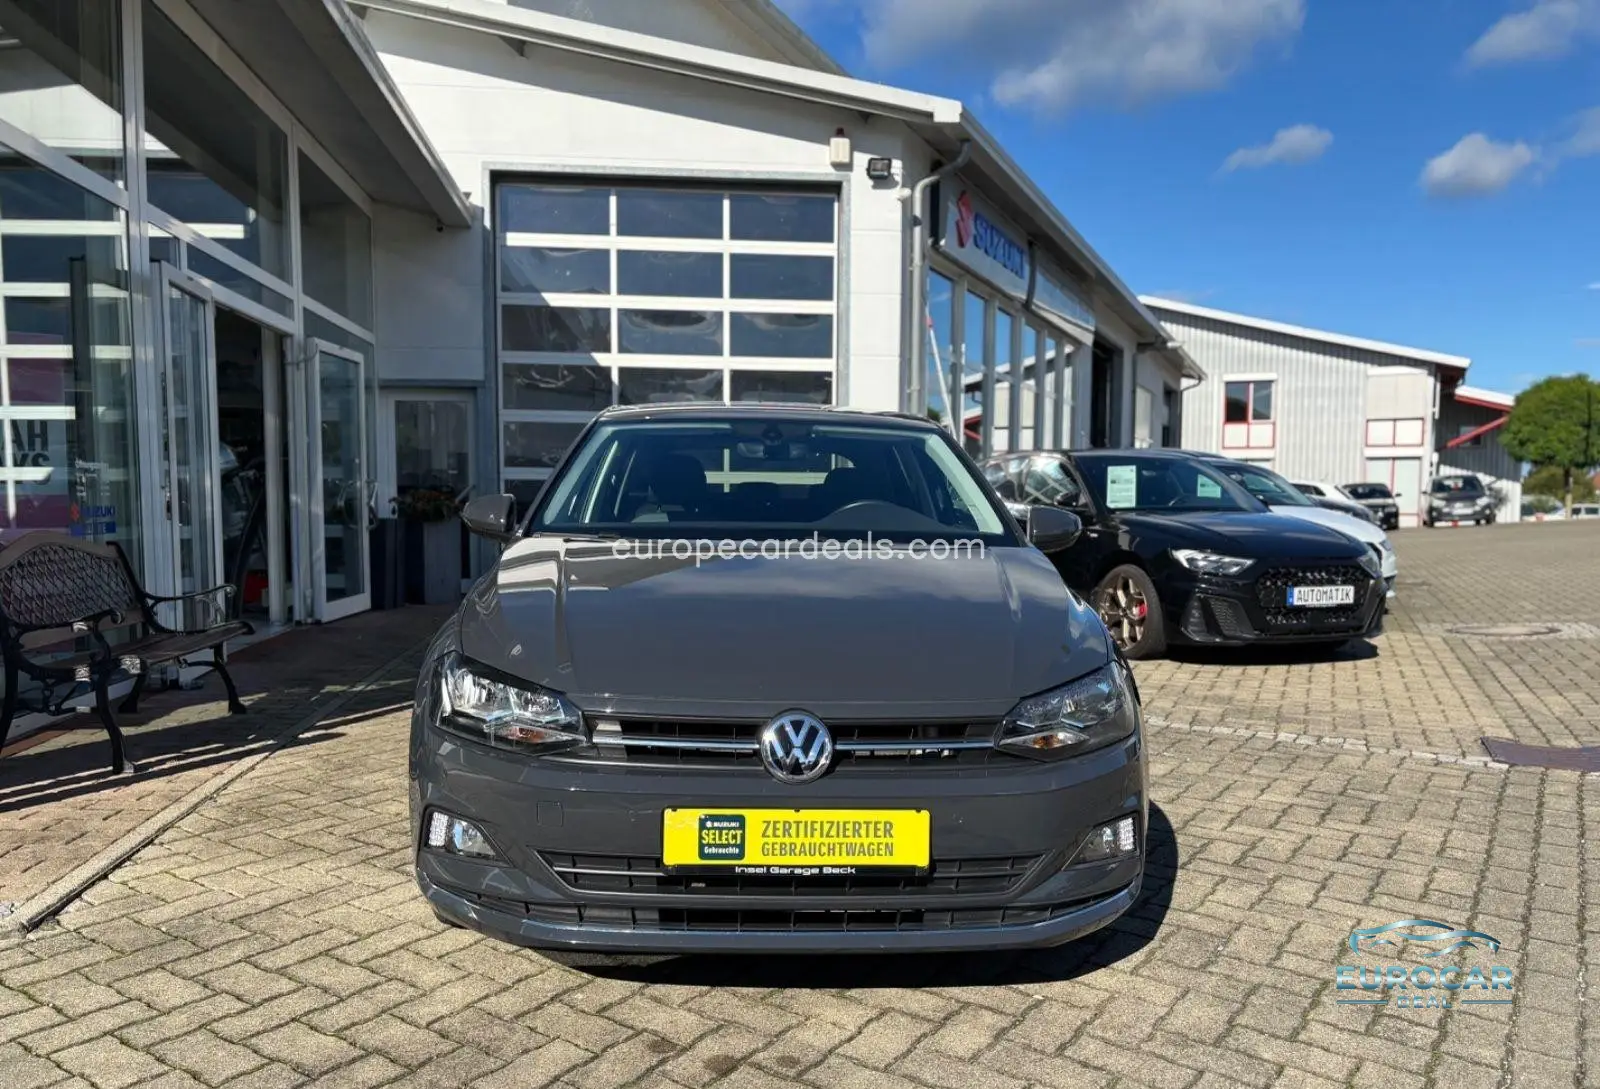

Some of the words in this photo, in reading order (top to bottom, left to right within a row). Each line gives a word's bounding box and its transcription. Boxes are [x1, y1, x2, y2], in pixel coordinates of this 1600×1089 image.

[1297, 587, 1351, 602] AUTOMATIK
[761, 820, 894, 838] ZERTIFIZIERTER
[701, 829, 743, 845] SELECT
[761, 842, 894, 857] GEBRAUCHTWAGEN
[735, 866, 767, 875] Insel
[769, 866, 820, 876] Garage
[822, 866, 857, 875] Beck
